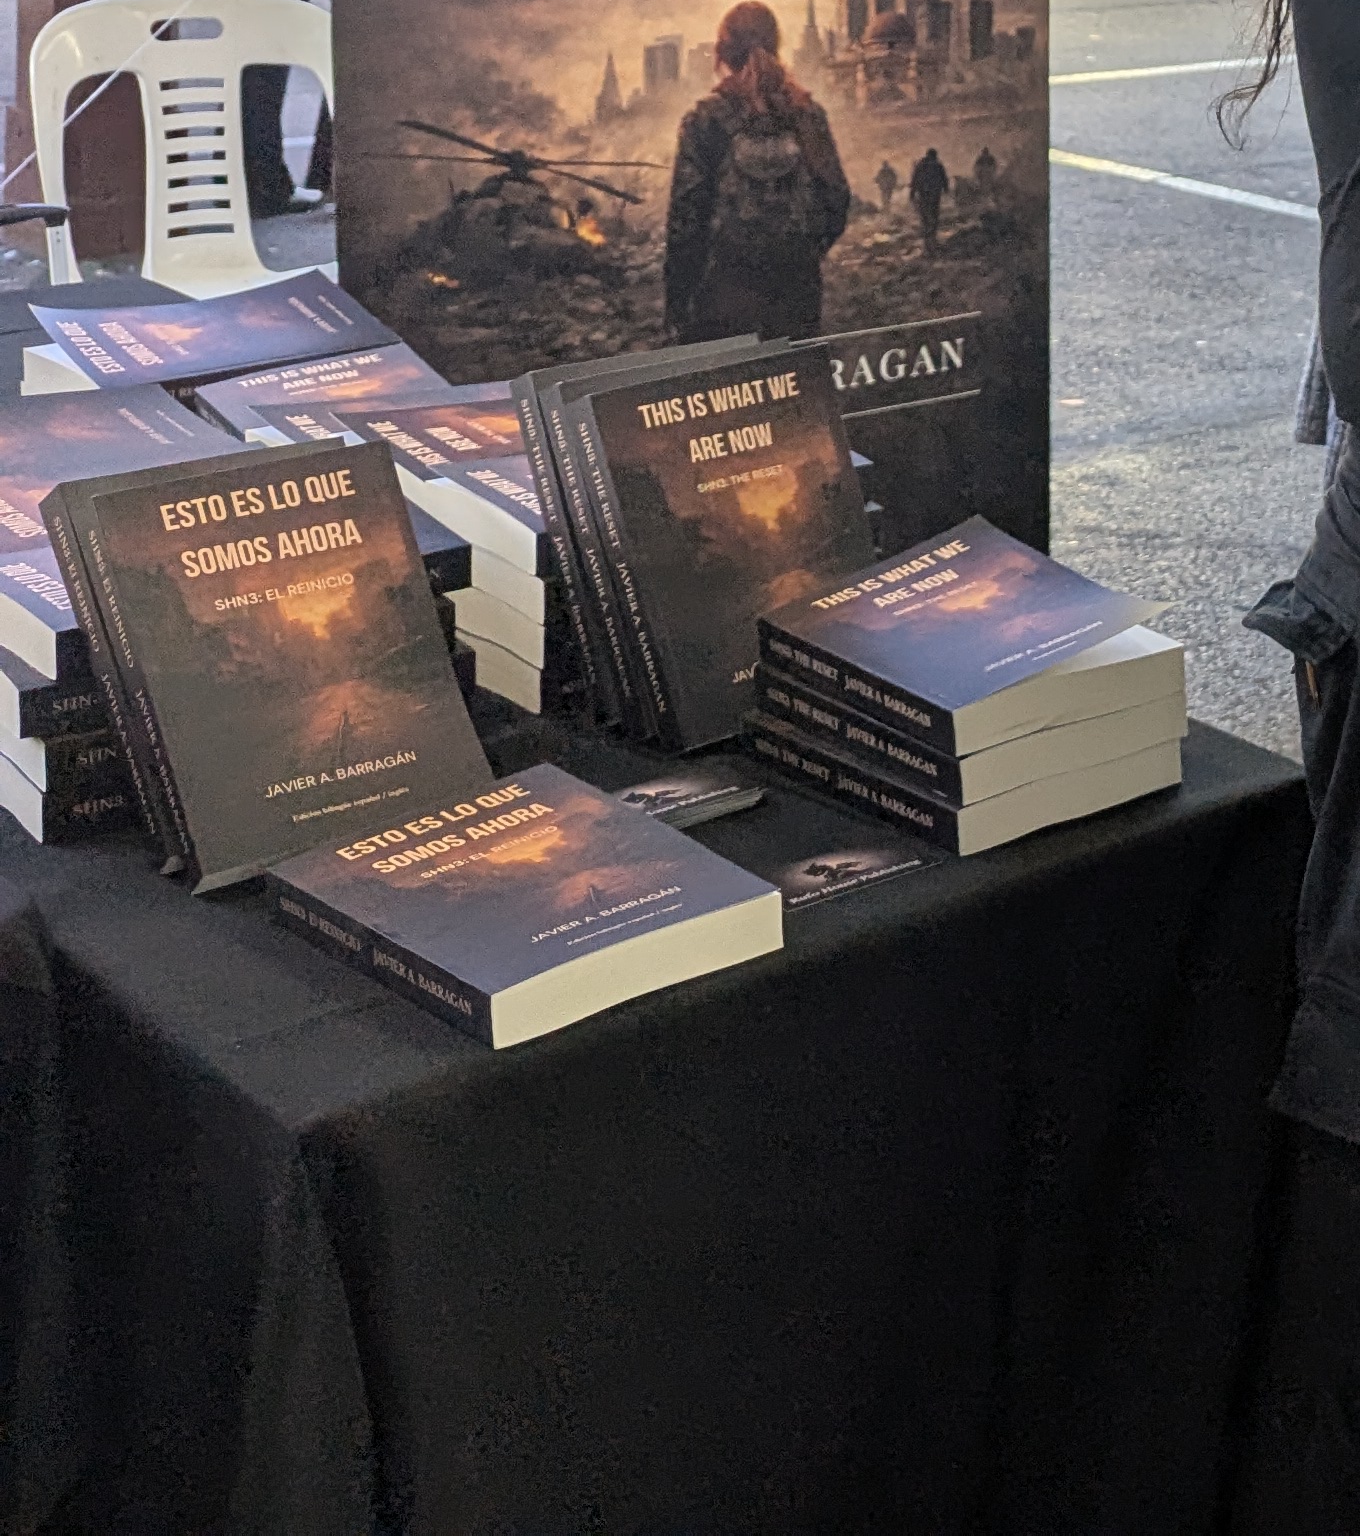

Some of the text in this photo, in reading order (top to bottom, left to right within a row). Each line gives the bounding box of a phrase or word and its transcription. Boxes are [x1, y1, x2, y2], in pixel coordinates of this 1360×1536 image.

[238, 354, 383, 387] THIS IS WHAT WE
[283, 378, 317, 390] ARE
[319, 370, 359, 381] NOW
[830, 337, 966, 390] RAGAN
[638, 372, 800, 428] THIS IS WHAT WE
[689, 422, 773, 463] ARE NOW
[160, 469, 356, 531] ESTO ES LO QUE
[181, 519, 362, 577] SOMOS AHORA
[601, 501, 619, 550] RESET
[616, 561, 637, 612] JAVIER
[810, 540, 970, 609] THIS IS WHAT WE
[215, 572, 354, 612] SHN3: EL REINICIO
[873, 587, 916, 608] ARE
[911, 569, 959, 592] NOW
[732, 667, 755, 683] JAV
[265, 751, 416, 798] JAVIER A. BARRAGÁN
[336, 784, 531, 861] ESTO ES LO QUE
[372, 802, 554, 874] SOMOS AHORA
[420, 825, 558, 879] SHN3: EL REINICIO
[531, 920, 582, 944] JAVIER
[585, 915, 600, 924] A.
